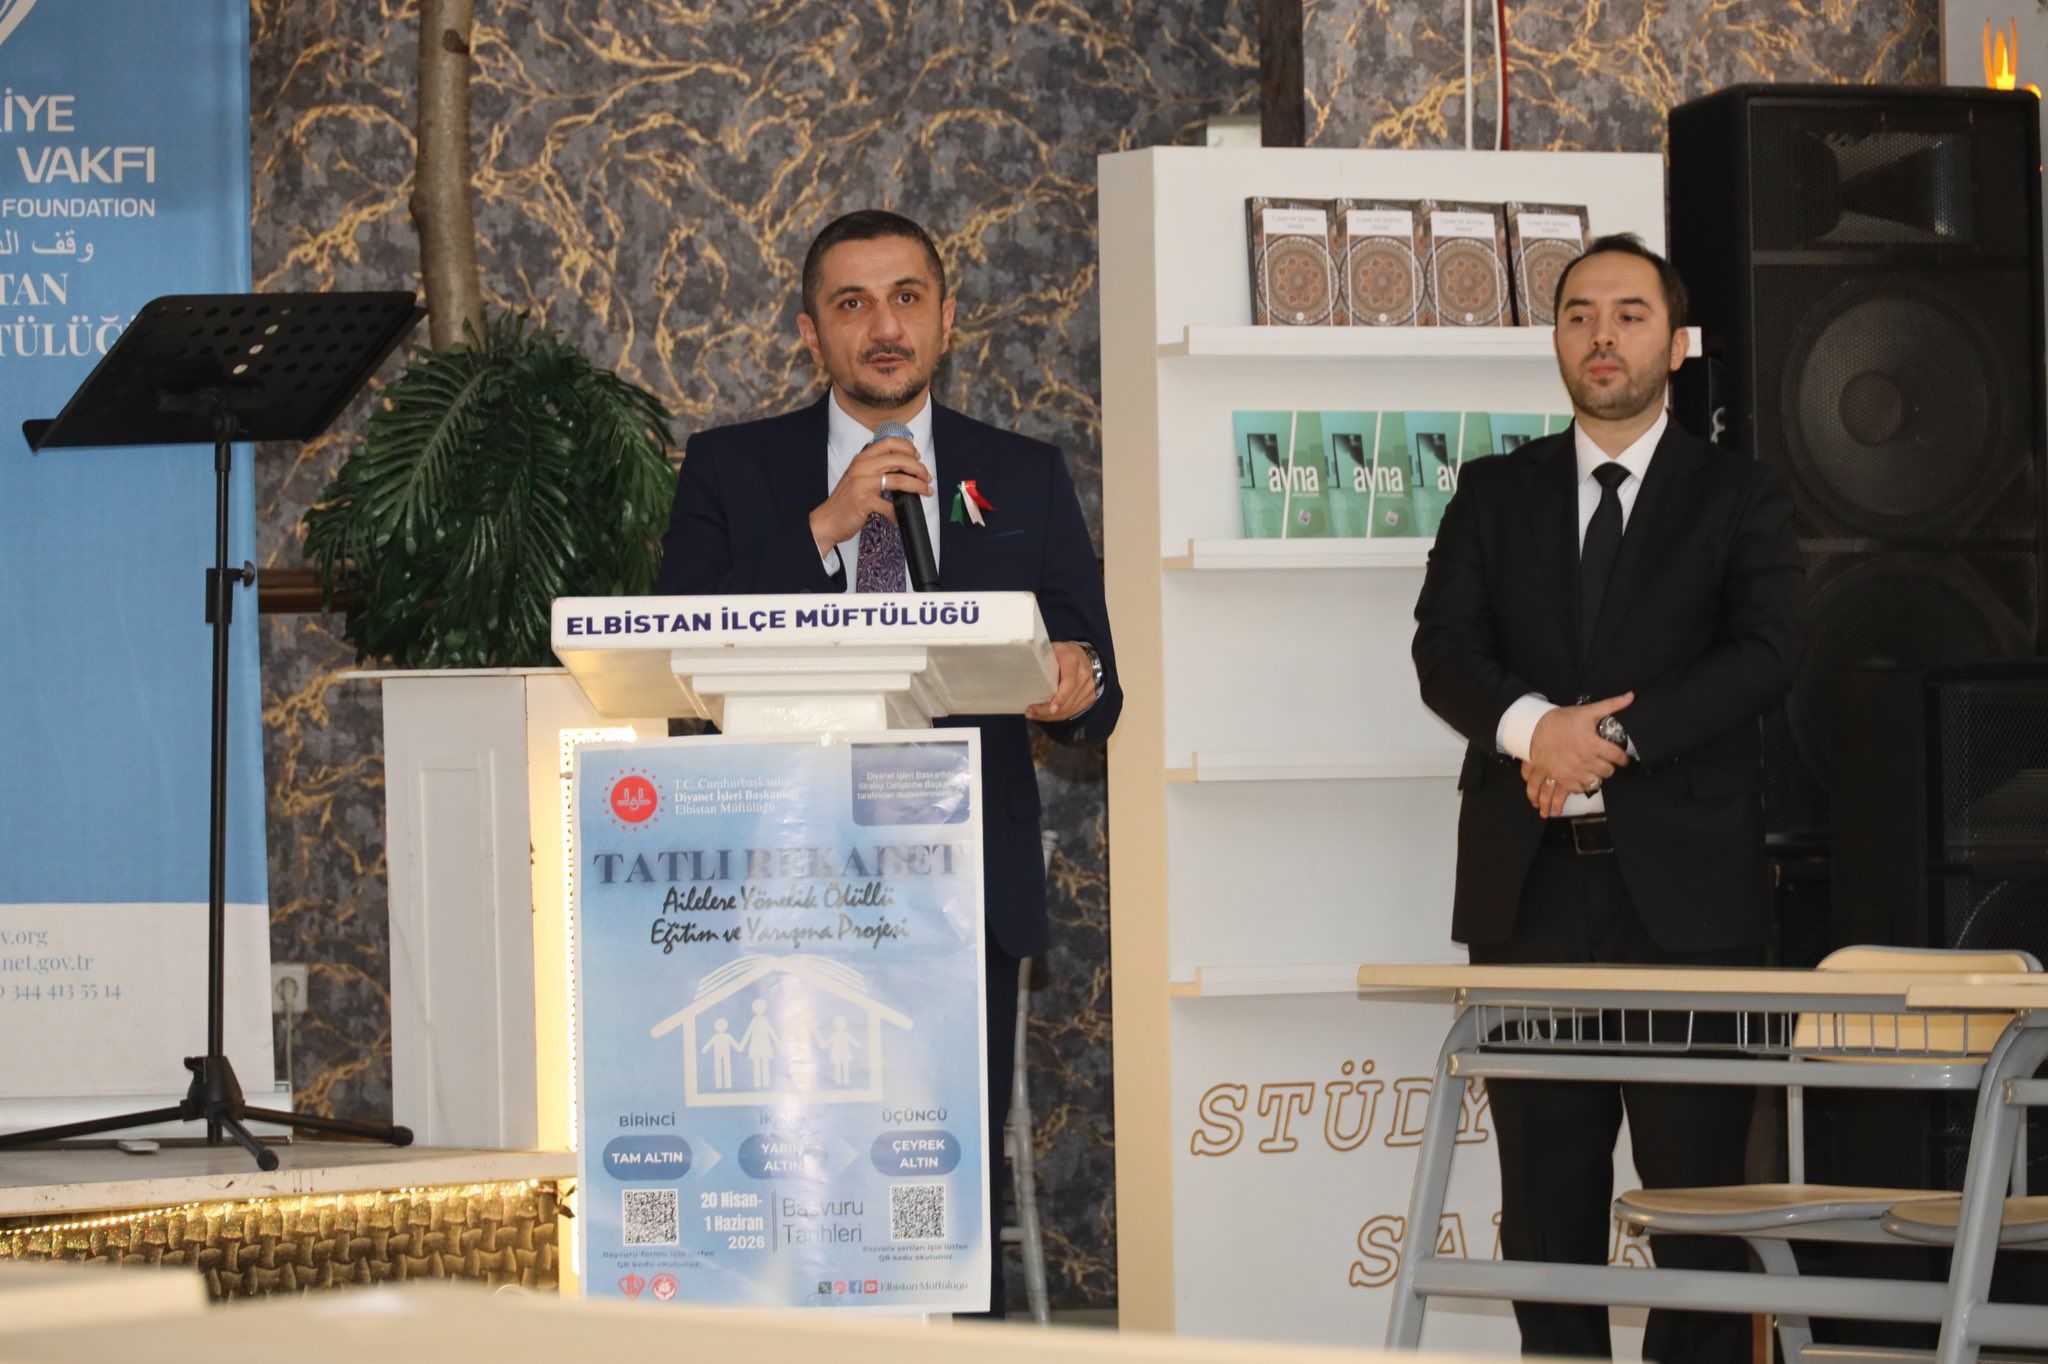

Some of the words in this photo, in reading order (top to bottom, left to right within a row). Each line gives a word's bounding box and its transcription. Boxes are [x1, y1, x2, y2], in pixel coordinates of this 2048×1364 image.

[0, 87, 75, 132] İYE
[17, 146, 155, 184] VAKFI
[2, 198, 155, 217] FOUNDATION
[0, 315, 137, 357] TÜLÜĞ
[1268, 466, 1319, 493] ayna
[1353, 466, 1405, 493] ayna
[566, 609, 712, 635] ELBİSTAN
[721, 606, 787, 632] İLÇE
[795, 600, 981, 629] MÜFTÜLÜĞÜ
[593, 849, 732, 884] TATLI
[662, 886, 737, 915] Ailelere
[650, 918, 718, 954] Eğitim
[723, 928, 741, 942] ve
[838, 914, 911, 949] Projesi
[619, 1111, 676, 1127] BİRİNCİ
[882, 1107, 948, 1125] ÜÇÜNCÜ
[1190, 1059, 1488, 1156] STÜDY
[611, 1151, 641, 1164] TAM
[644, 1150, 683, 1163] ALTIN
[892, 1138, 946, 1153] ÇEYREK
[900, 1156, 939, 1169] ALTIN
[701, 1192, 718, 1208] 20
[705, 1215, 712, 1232] 1
[714, 1214, 764, 1231] Haziran
[728, 1236, 766, 1249] 2026
